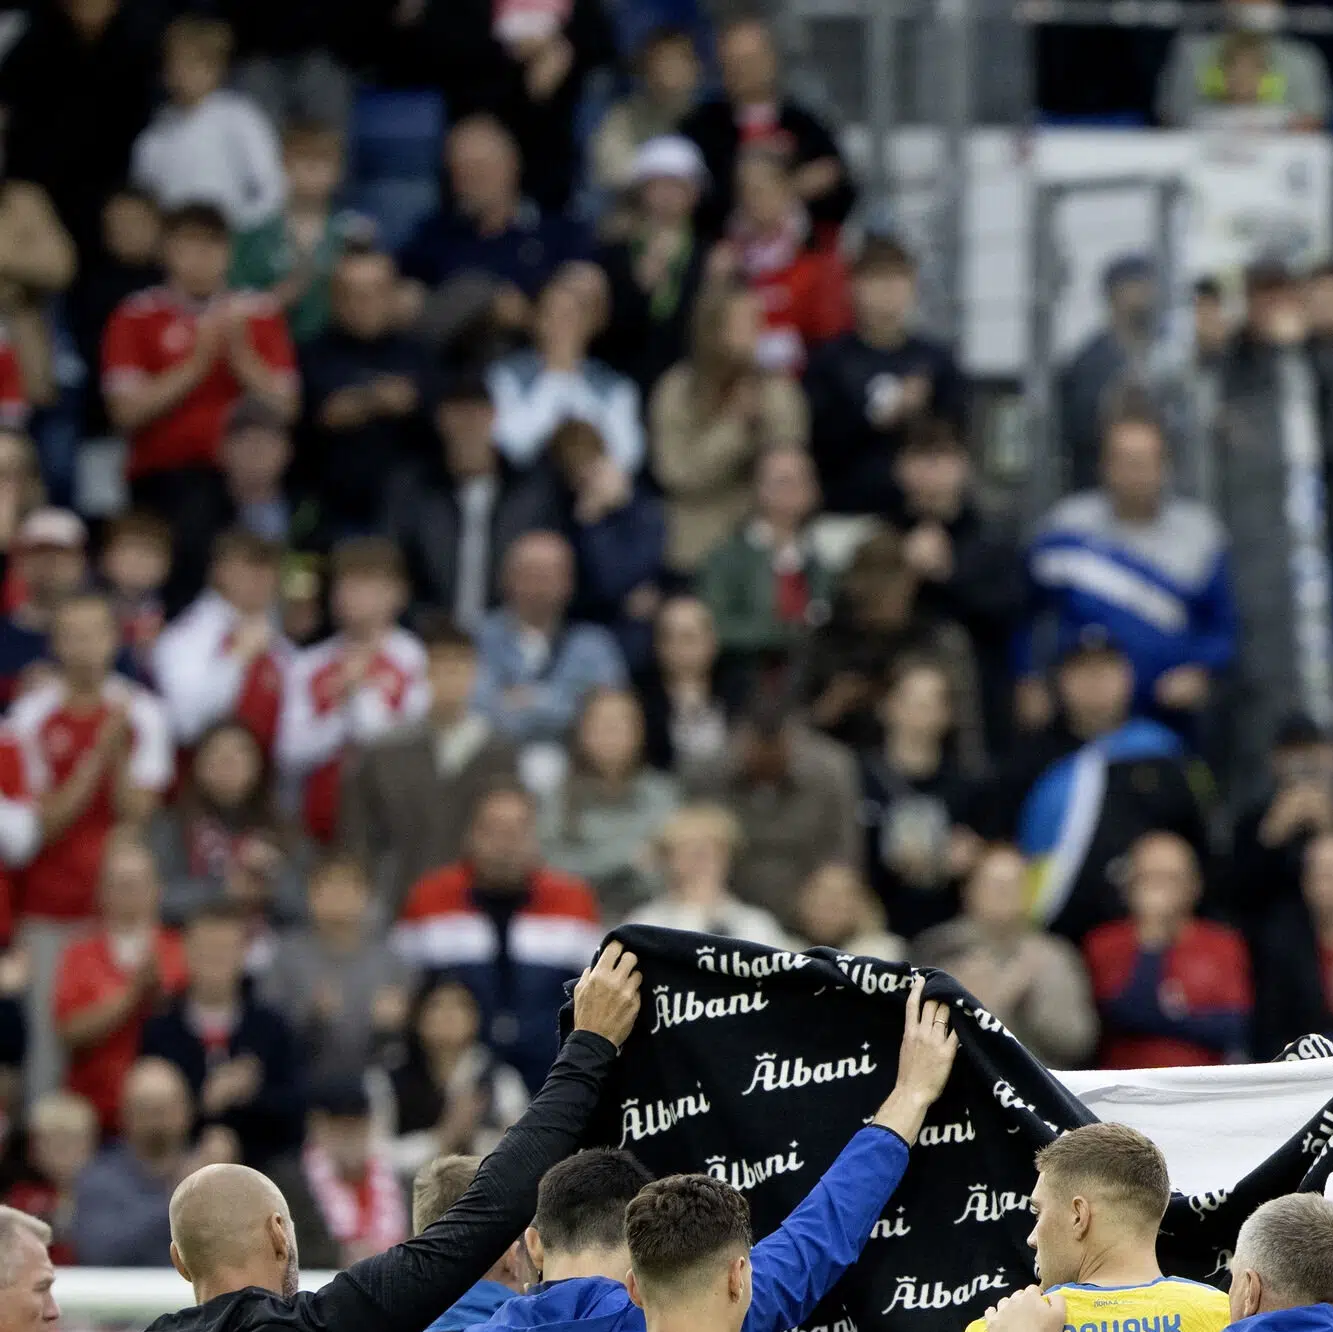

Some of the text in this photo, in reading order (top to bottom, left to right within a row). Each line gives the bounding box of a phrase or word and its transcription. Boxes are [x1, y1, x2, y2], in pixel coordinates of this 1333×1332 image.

[650, 981, 769, 1034] Albani
[741, 1041, 877, 1096] Albani
[882, 1266, 1009, 1315] Albani
